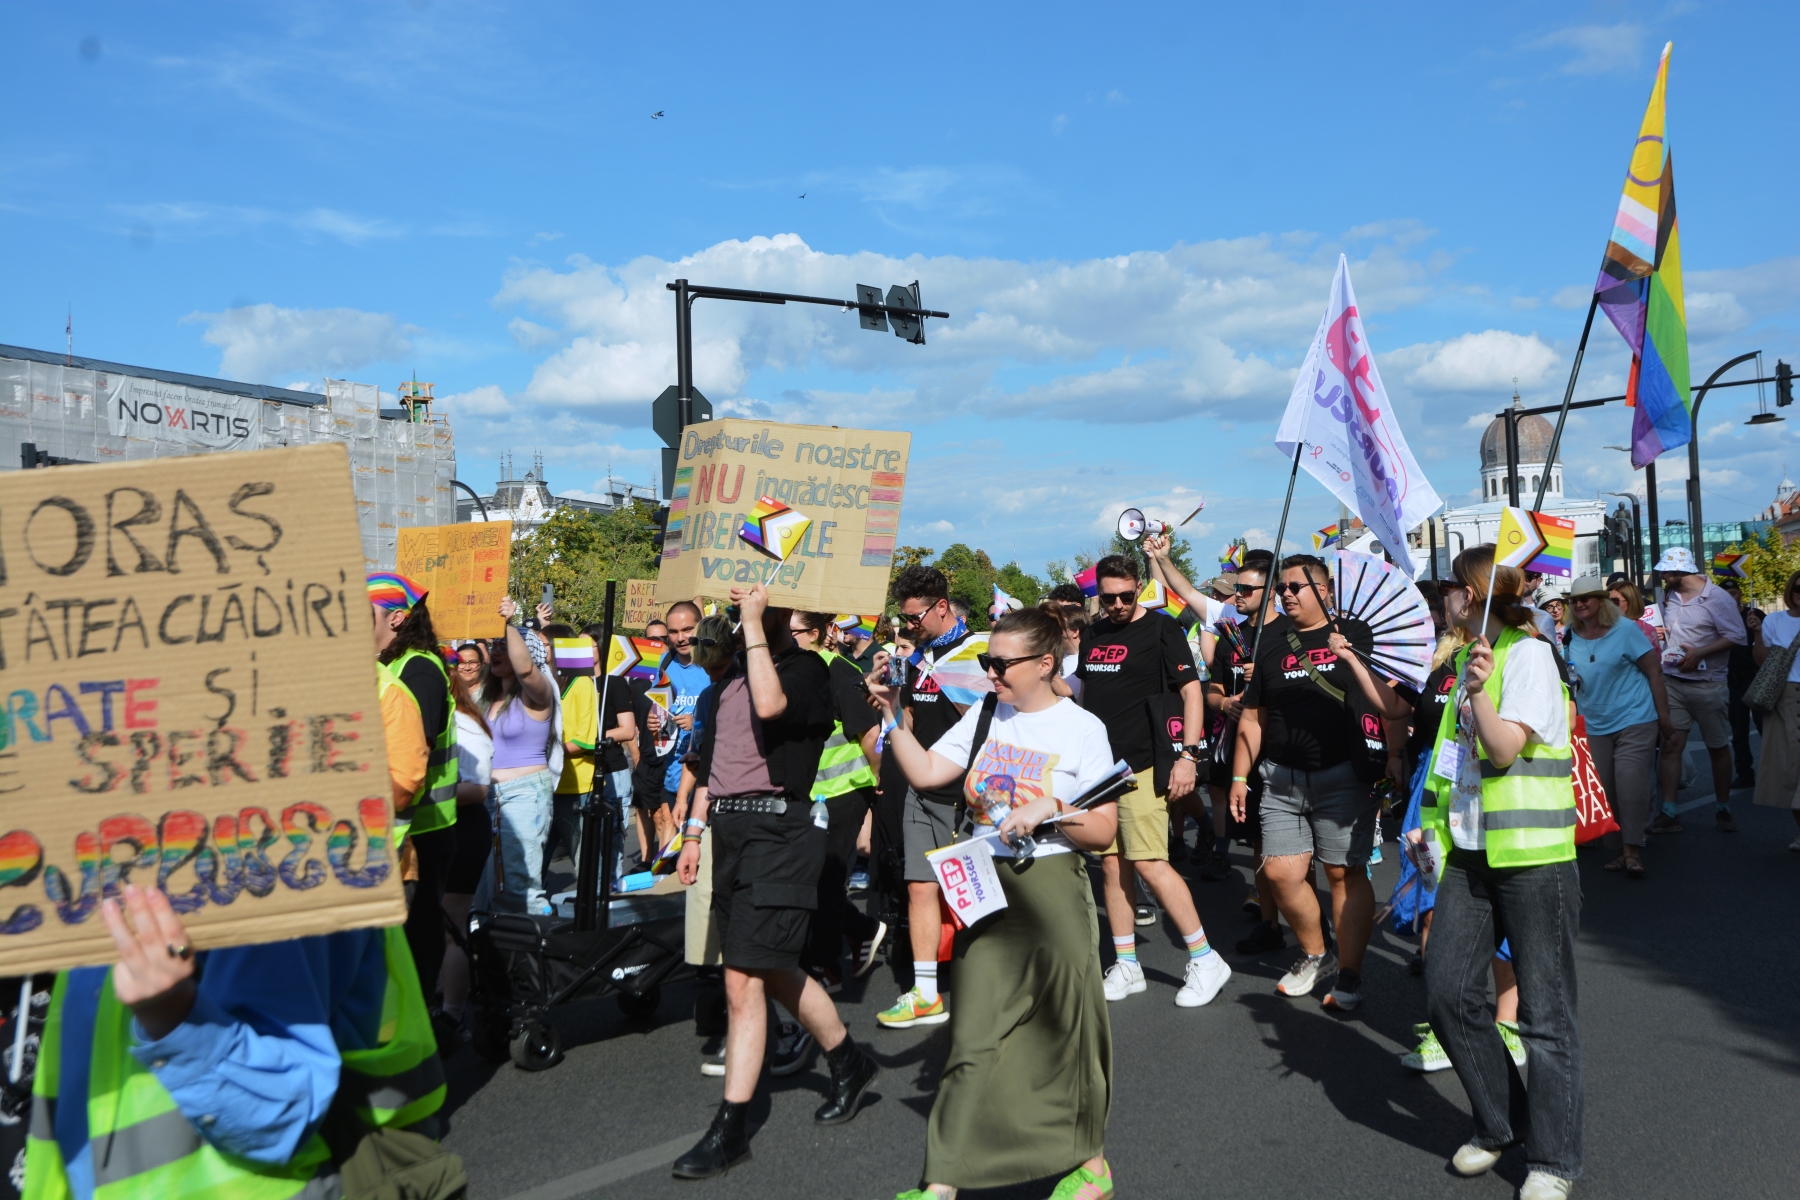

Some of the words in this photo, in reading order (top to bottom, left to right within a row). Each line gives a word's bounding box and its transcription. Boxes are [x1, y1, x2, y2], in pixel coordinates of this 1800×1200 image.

[162, 390, 183, 402] facem
[184, 395, 206, 406] Oradea
[119, 397, 250, 439] NOVARTIS
[684, 429, 784, 461] Drepturile
[796, 442, 901, 472] noastre
[695, 463, 745, 506] NU
[754, 469, 870, 510] îngrădesc
[402, 532, 440, 558] WE
[446, 530, 467, 553] ARE
[400, 556, 424, 577] WE
[701, 555, 805, 590] voastre!
[630, 597, 643, 608] NU
[1088, 646, 1127, 662] PrEP
[1085, 664, 1121, 673] YOURSELF
[0, 679, 161, 752] RATE
[986, 739, 1050, 766] DAVID
[973, 756, 1044, 782] BOWIE
[941, 858, 972, 911] PrEP
[962, 854, 985, 903] YOURSELF
